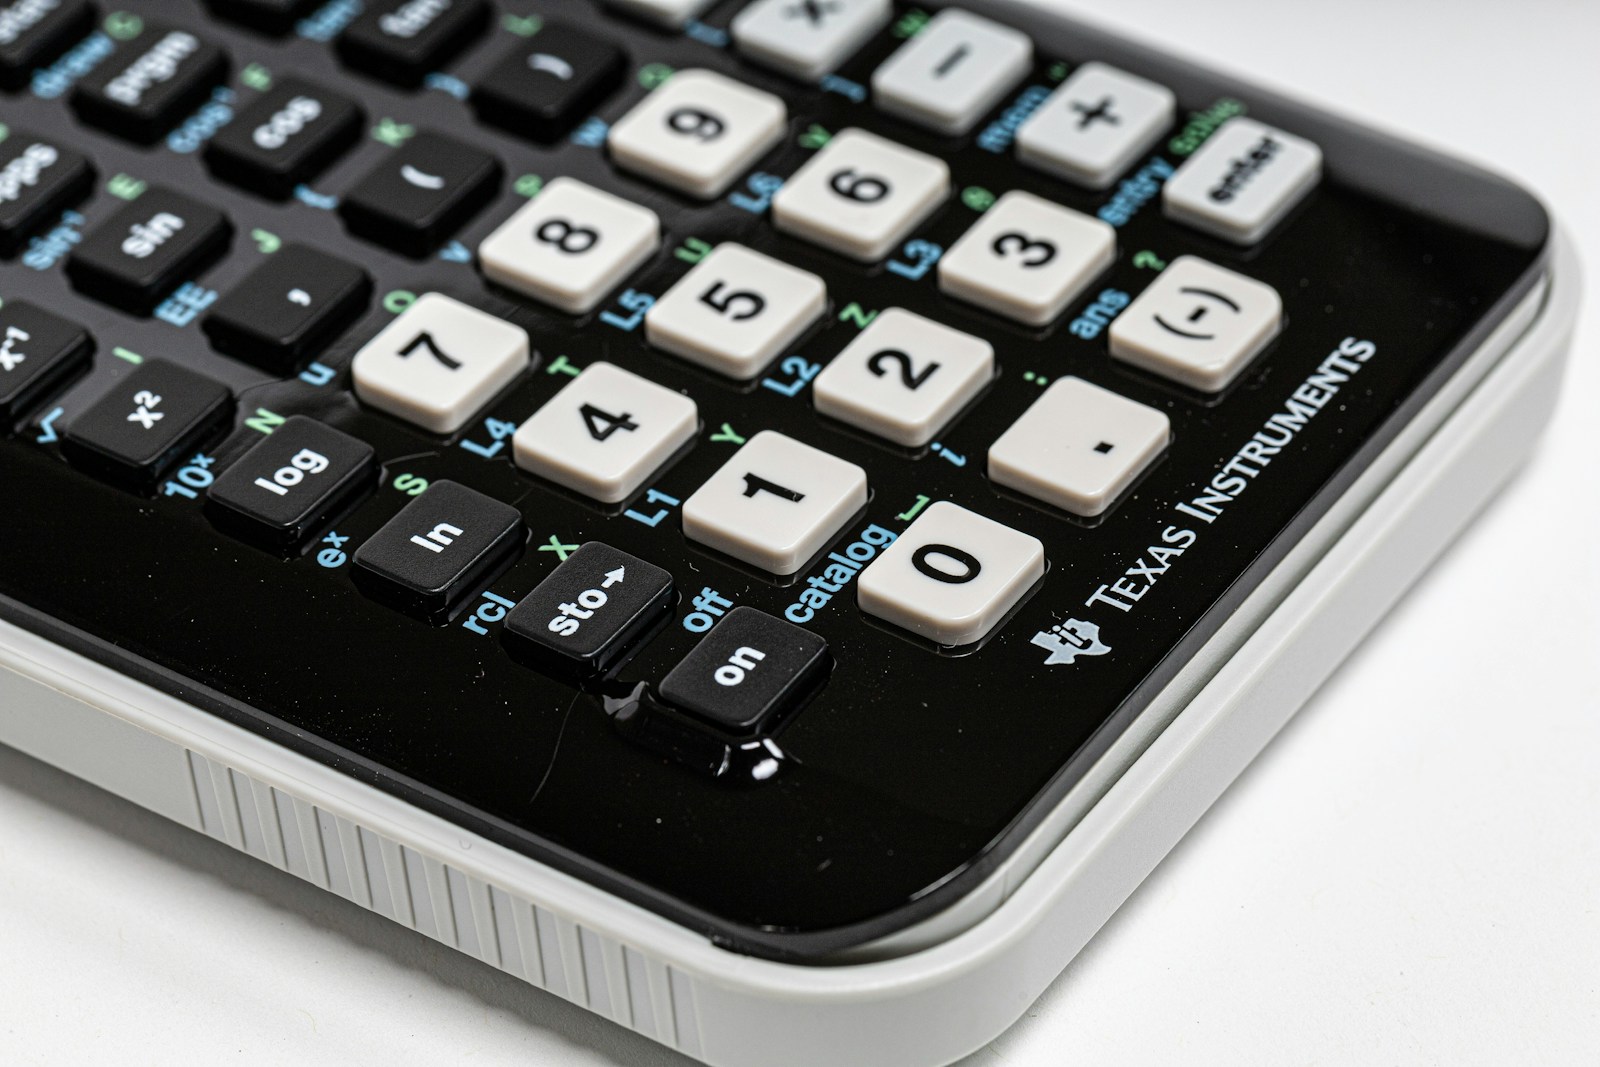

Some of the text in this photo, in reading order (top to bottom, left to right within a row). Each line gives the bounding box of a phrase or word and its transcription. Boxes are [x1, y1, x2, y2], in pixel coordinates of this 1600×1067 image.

[103, 31, 198, 106] prgm
[253, 96, 322, 149] cos
[666, 107, 726, 142] 9
[107, 173, 146, 199] E
[828, 168, 891, 204] 6
[1207, 132, 1283, 204] enter
[728, 171, 785, 213] L6
[1097, 156, 1178, 227] entry
[121, 212, 185, 258] sin
[252, 228, 281, 253] J
[535, 215, 600, 254] 8
[991, 230, 1058, 269] 3
[886, 238, 943, 280] L3
[154, 281, 218, 327] EE
[599, 288, 657, 331] L5
[697, 279, 766, 322] 5
[839, 302, 879, 329] Z
[1069, 287, 1131, 340] ans
[397, 330, 463, 371] 7
[547, 355, 582, 378] T
[866, 347, 942, 391] 2
[762, 355, 821, 397] L2
[245, 408, 287, 435] N
[460, 416, 517, 458] L4
[578, 403, 640, 442] 4
[710, 423, 747, 446] Y
[254, 448, 330, 496] log
[393, 472, 429, 496] S
[743, 471, 806, 504] 1
[1085, 336, 1377, 613] TEXAS INSTRUMENTS
[624, 488, 681, 527] L1
[538, 534, 580, 562] X
[911, 543, 982, 585] 0
[784, 523, 898, 624] catalog
[462, 591, 516, 635] rcl
[547, 588, 609, 637] sto
[683, 586, 734, 633] off
[714, 645, 766, 687] on
